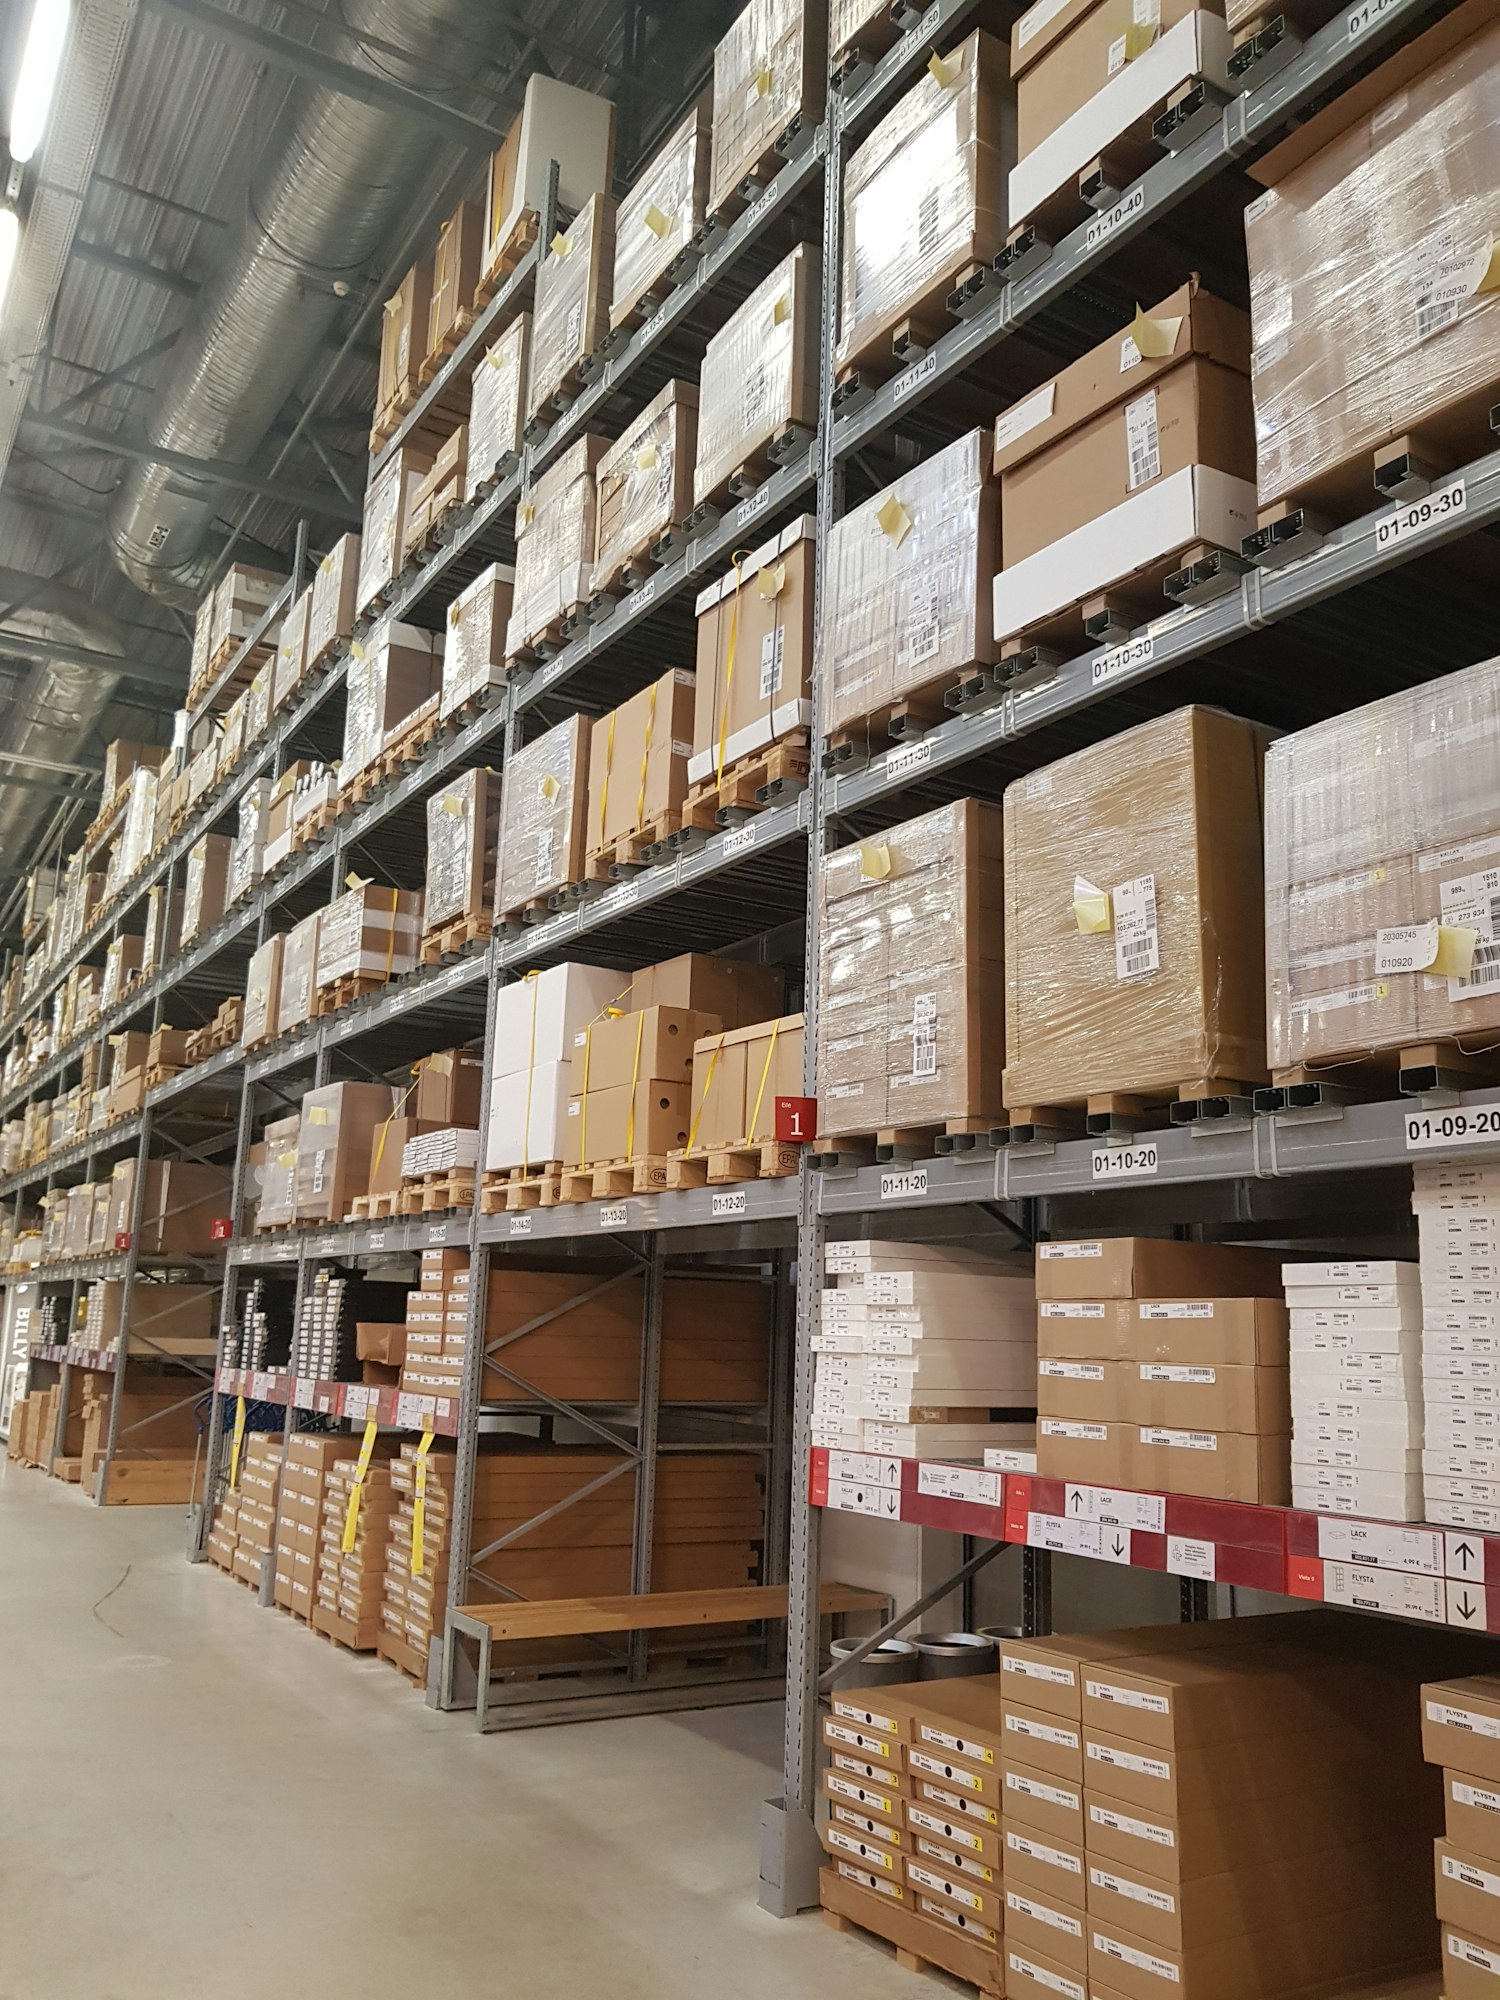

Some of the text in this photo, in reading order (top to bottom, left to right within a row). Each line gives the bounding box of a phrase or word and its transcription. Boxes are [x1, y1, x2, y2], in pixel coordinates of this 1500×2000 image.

[1088, 192, 1142, 243] 01-10-40
[1436, 284, 1468, 301] 010930
[895, 357, 935, 396] 01-11-40
[738, 491, 767, 522] 01-12-40
[1379, 488, 1463, 542] 01-09-30
[1094, 640, 1151, 677] 01-10-30
[888, 745, 930, 773] 01-11-30
[724, 829, 754, 851] 01-12-30
[1483, 872, 1498, 881] 1510
[1487, 880, 1498, 889] 810
[1458, 908, 1485, 921] 273 934
[1382, 931, 1417, 941] 20305745
[1381, 957, 1413, 968] 010920
[1379, 985, 1385, 994] 1
[790, 1112, 804, 1136] 1
[1409, 1111, 1500, 1140] 01-09-20
[1094, 1150, 1156, 1172] 01-10-20
[883, 1175, 926, 1193] 01-11-20
[714, 1196, 745, 1210] 01-12-20
[601, 1210, 627, 1222] 01-13-20
[12, 1307, 31, 1360] BILLY
[1100, 1496, 1112, 1504] LACK
[1351, 1530, 1367, 1538] LACK
[1352, 1574, 1375, 1583] FLYSTA
[1446, 1709, 1468, 1719] FLYSTA
[891, 1721, 897, 1730] 3
[881, 1745, 886, 1754] 1
[986, 1751, 992, 1760] 4
[892, 1775, 897, 1783] 3
[974, 1779, 979, 1789] 2
[1473, 1790, 1497, 1802] FLYSTA
[883, 1801, 888, 1810] 1
[990, 1812, 996, 1821] 4
[894, 1833, 899, 1841] 3
[974, 1839, 979, 1849] 2
[885, 1857, 890, 1866] 1
[985, 1869, 991, 1878] 4
[1460, 1864, 1479, 1874] FLYSTA
[897, 1887, 902, 1895] 3
[974, 1898, 979, 1908] 2
[989, 1931, 995, 1940] 4
[1466, 1943, 1485, 1955] FLYSTA
